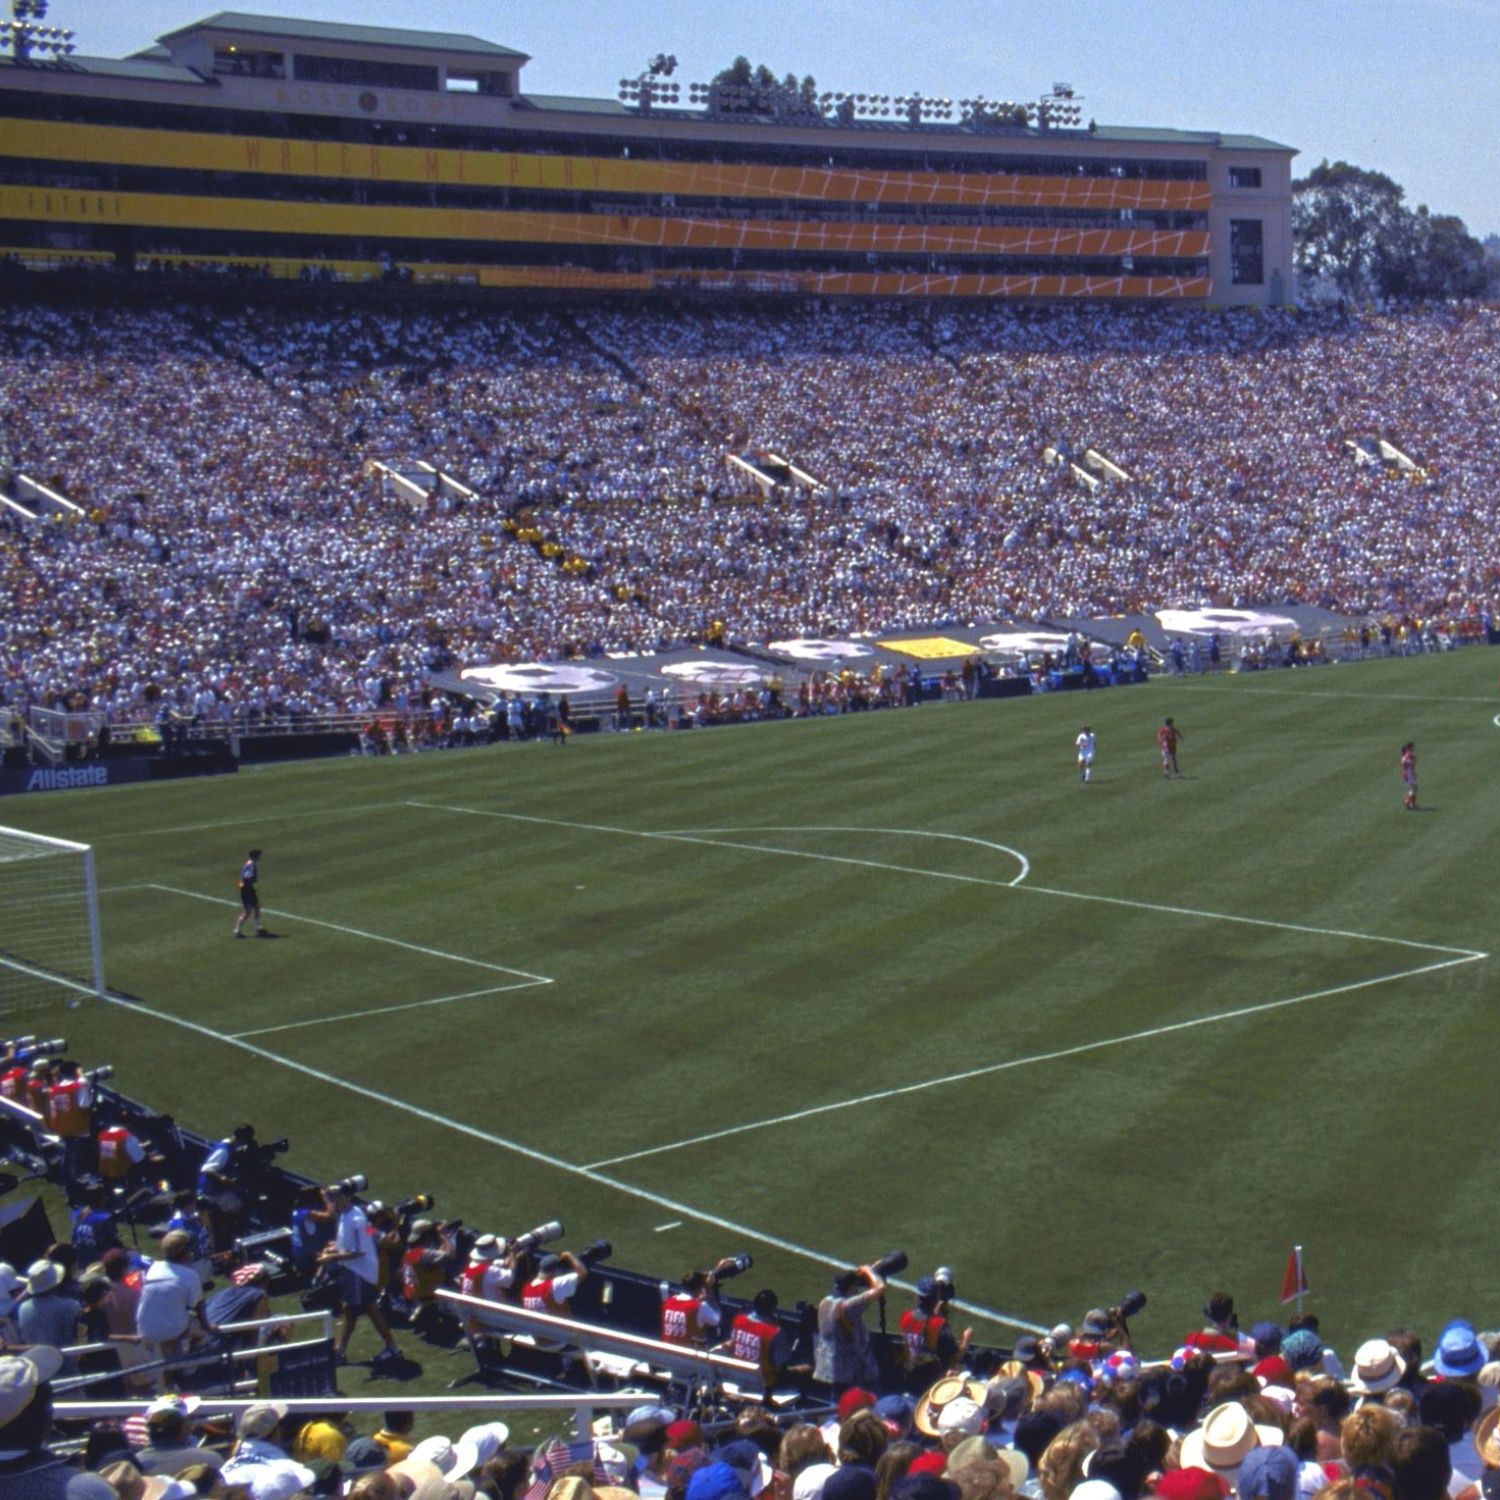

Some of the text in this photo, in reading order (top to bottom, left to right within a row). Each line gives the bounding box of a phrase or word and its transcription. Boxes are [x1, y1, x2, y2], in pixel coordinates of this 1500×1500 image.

[246, 140, 599, 188] WATCH ME PLAY
[27, 765, 108, 791] Allstate
[665, 1309, 687, 1324] FIFA
[737, 1329, 760, 1345] FIFA
